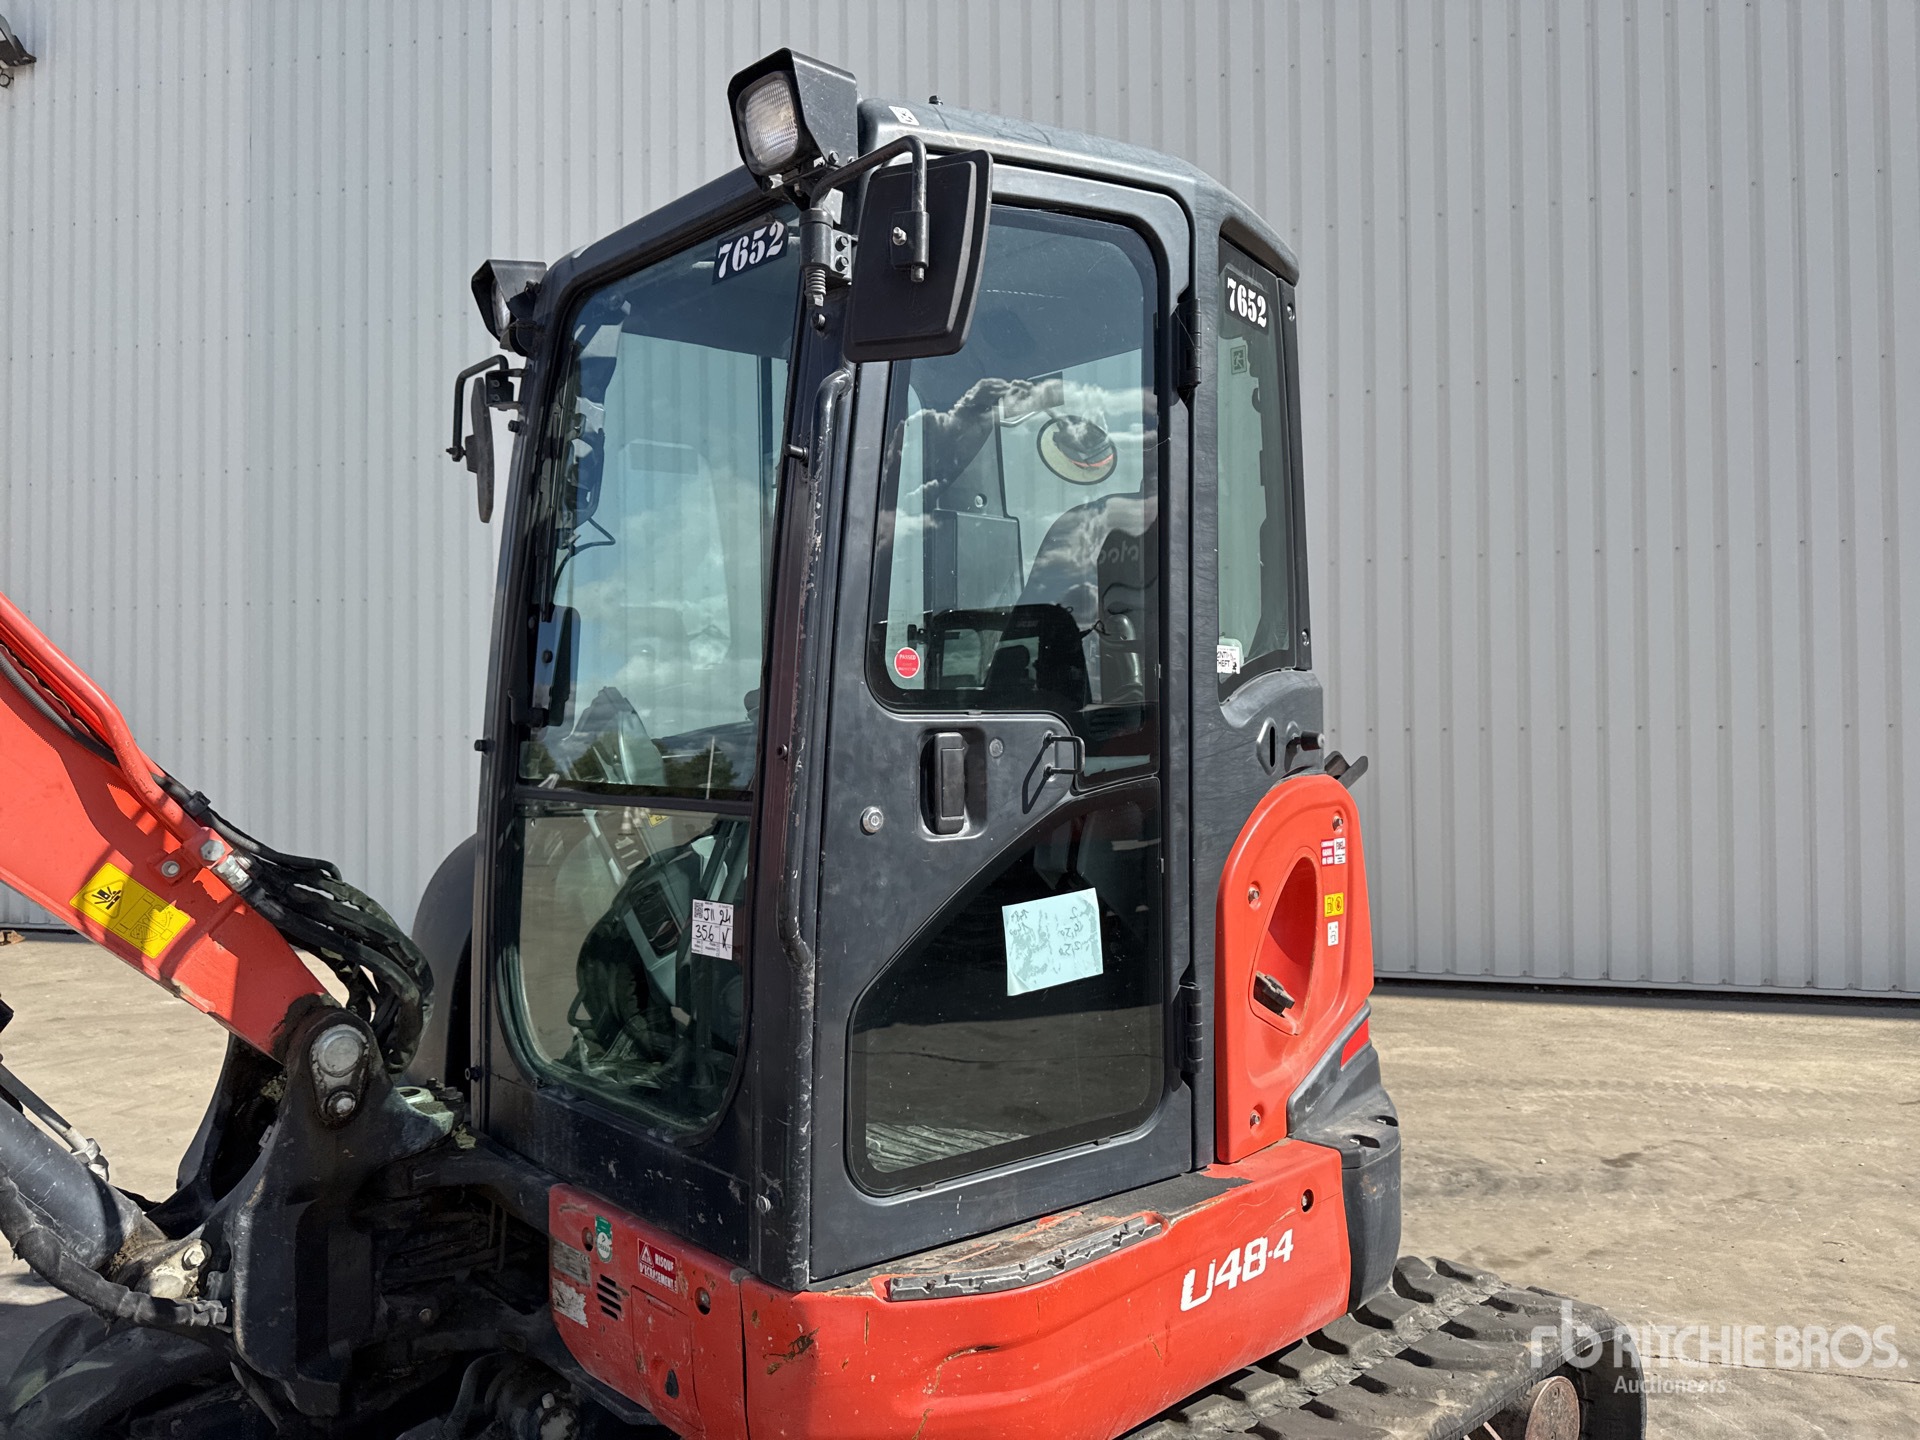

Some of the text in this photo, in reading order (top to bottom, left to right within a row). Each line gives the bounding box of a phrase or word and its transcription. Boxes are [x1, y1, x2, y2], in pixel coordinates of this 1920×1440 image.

[718, 220, 784, 279] 7652
[1227, 277, 1267, 328] 7652
[1217, 659, 1230, 667] HEFT
[695, 925, 715, 942] 356
